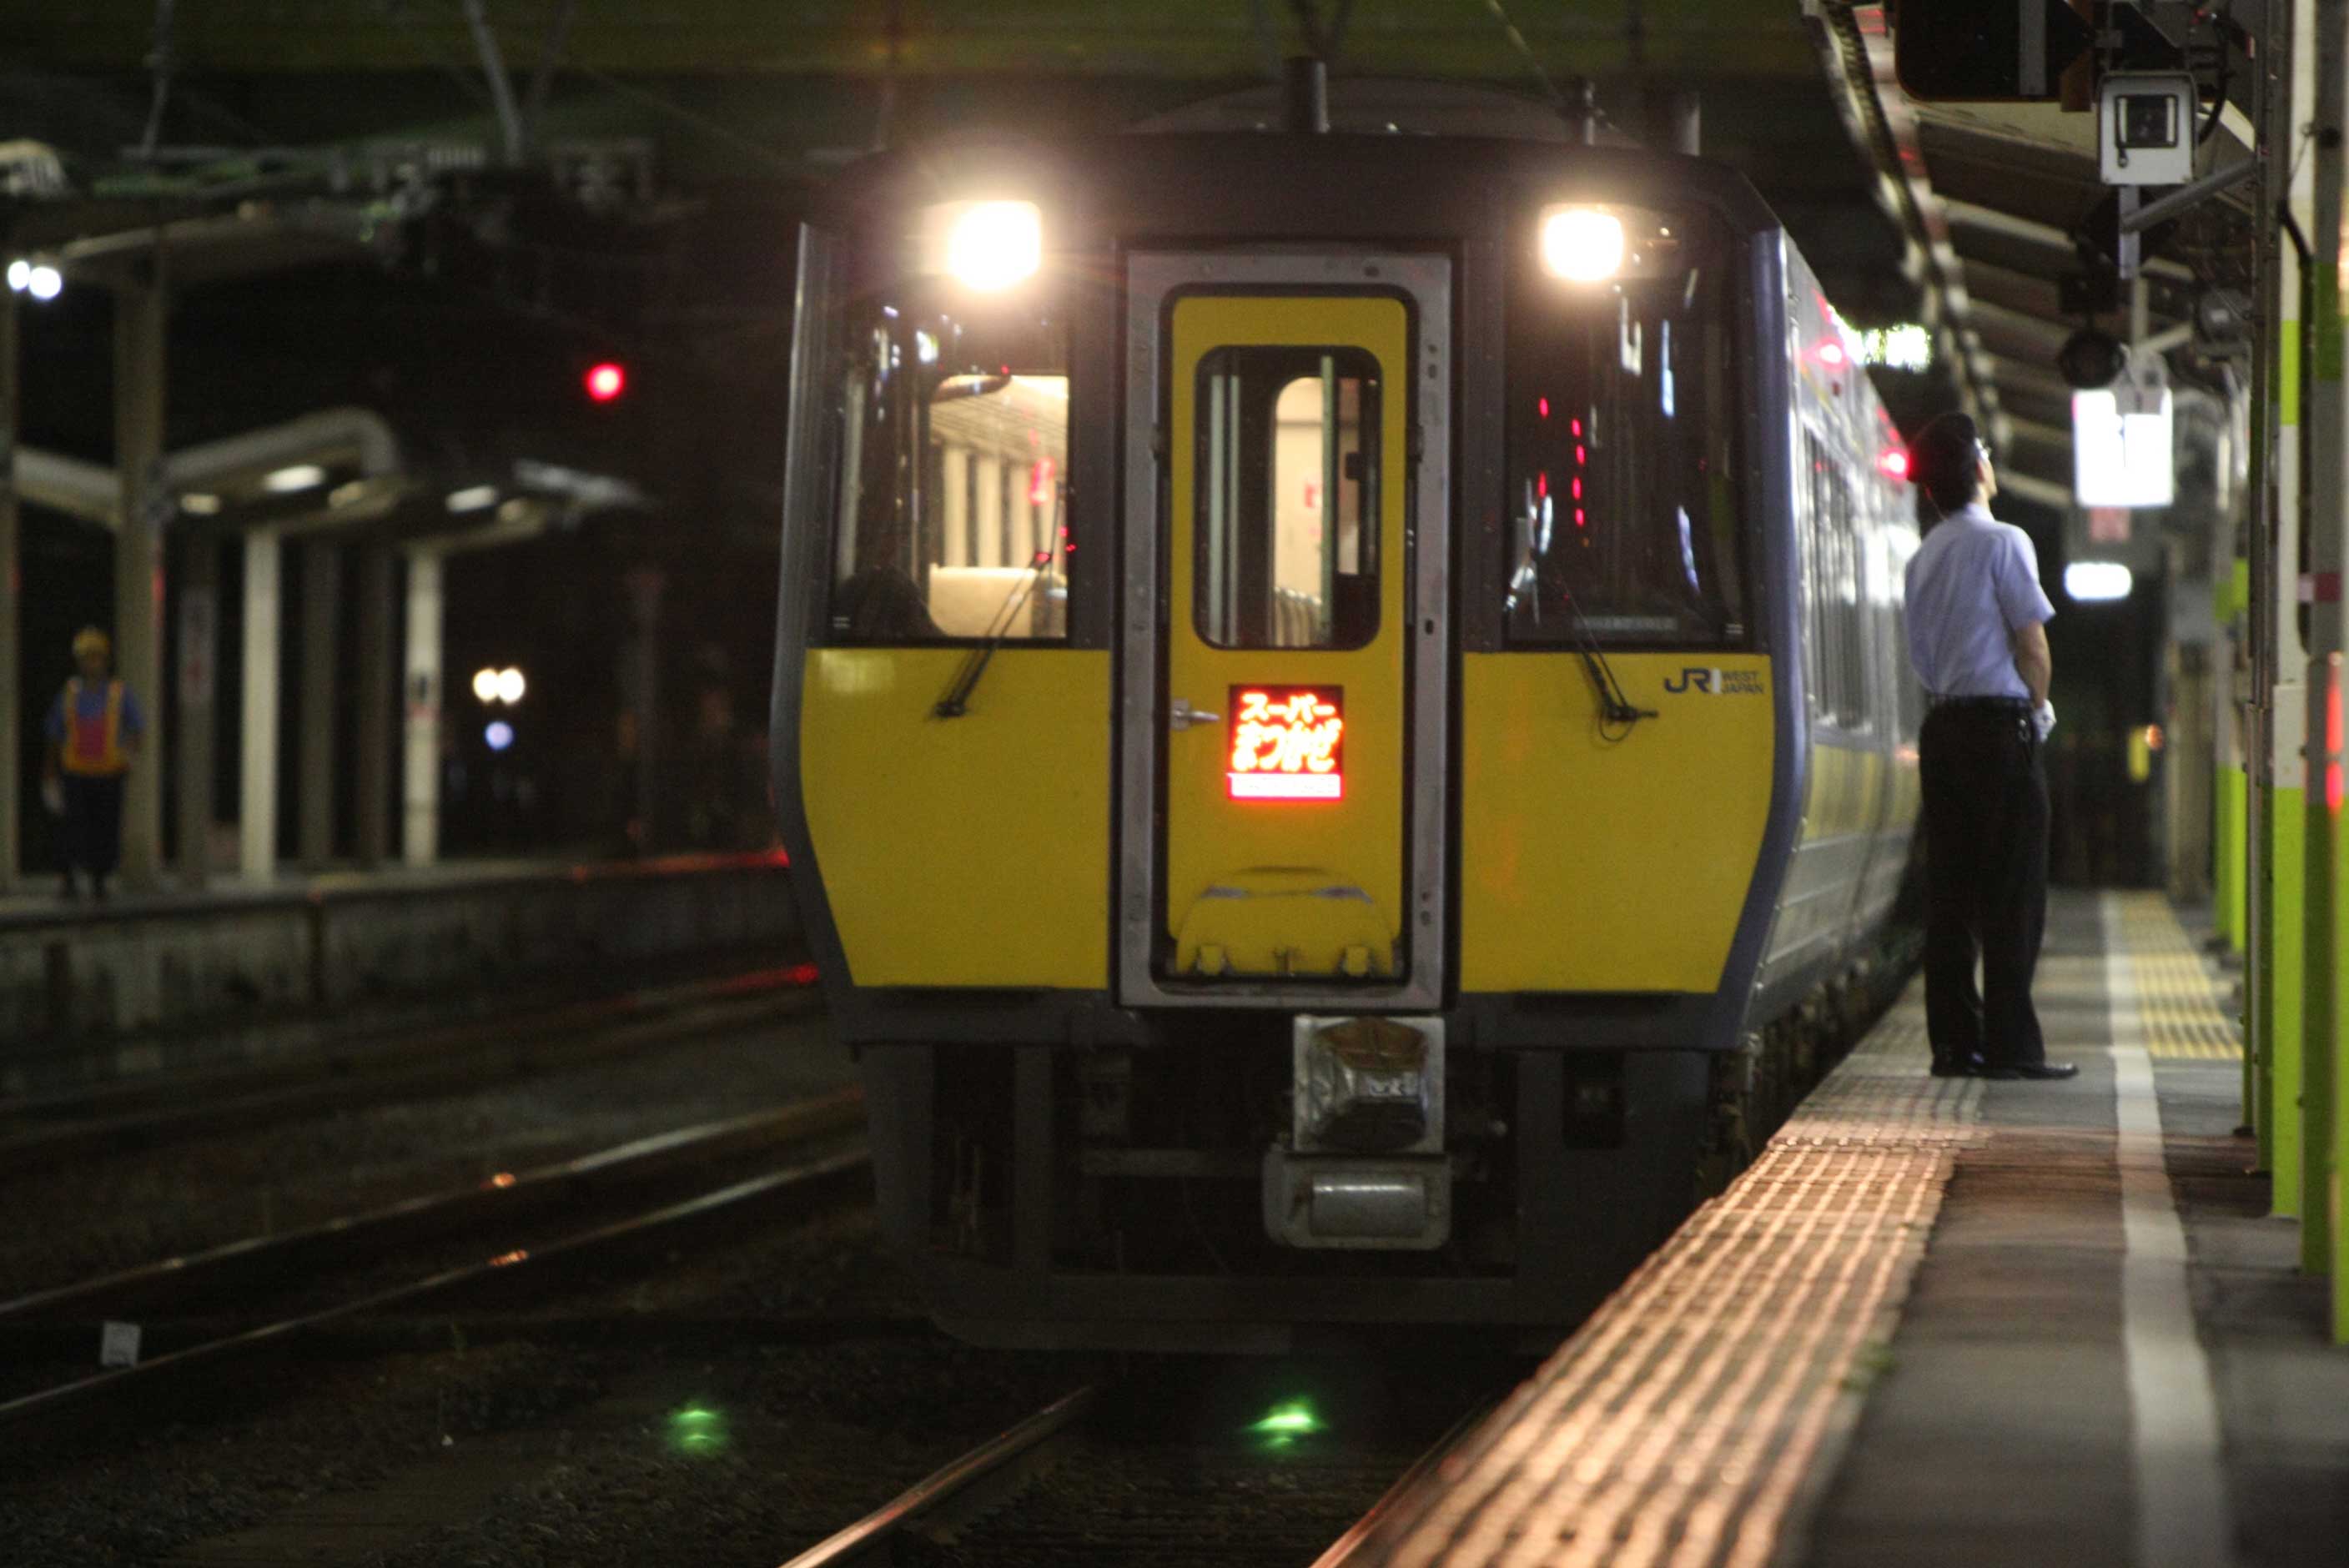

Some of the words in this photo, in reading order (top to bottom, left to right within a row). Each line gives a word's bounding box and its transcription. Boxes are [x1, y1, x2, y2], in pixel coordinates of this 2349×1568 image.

[1664, 668, 1709, 694] JR
[1722, 671, 1758, 681] WEST
[1722, 683, 1764, 694] JAPAN
[1240, 693, 1335, 723] スーパー
[1232, 718, 1342, 772] まつかぜ
